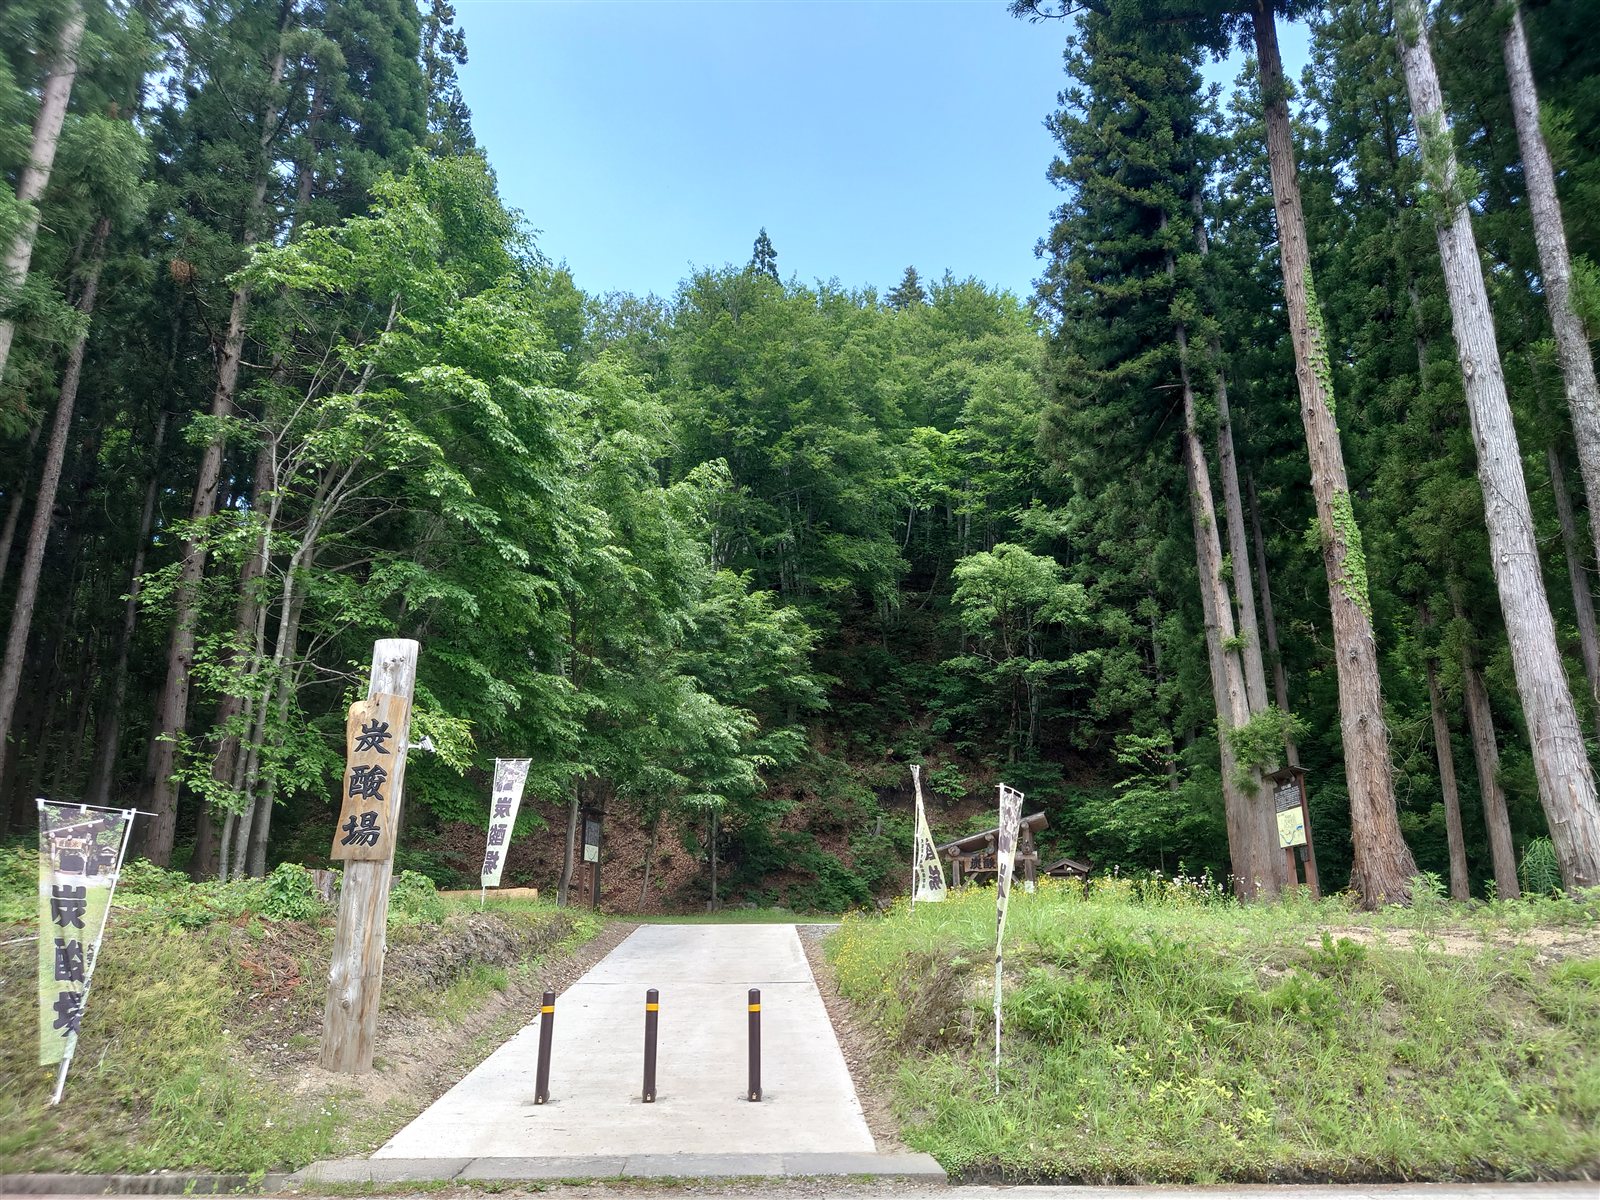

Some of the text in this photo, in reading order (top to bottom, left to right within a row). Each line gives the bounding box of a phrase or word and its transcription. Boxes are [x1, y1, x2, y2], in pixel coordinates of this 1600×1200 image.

[341, 718, 392, 848] 炭酸場
[50, 884, 87, 1038] 炭酸場
